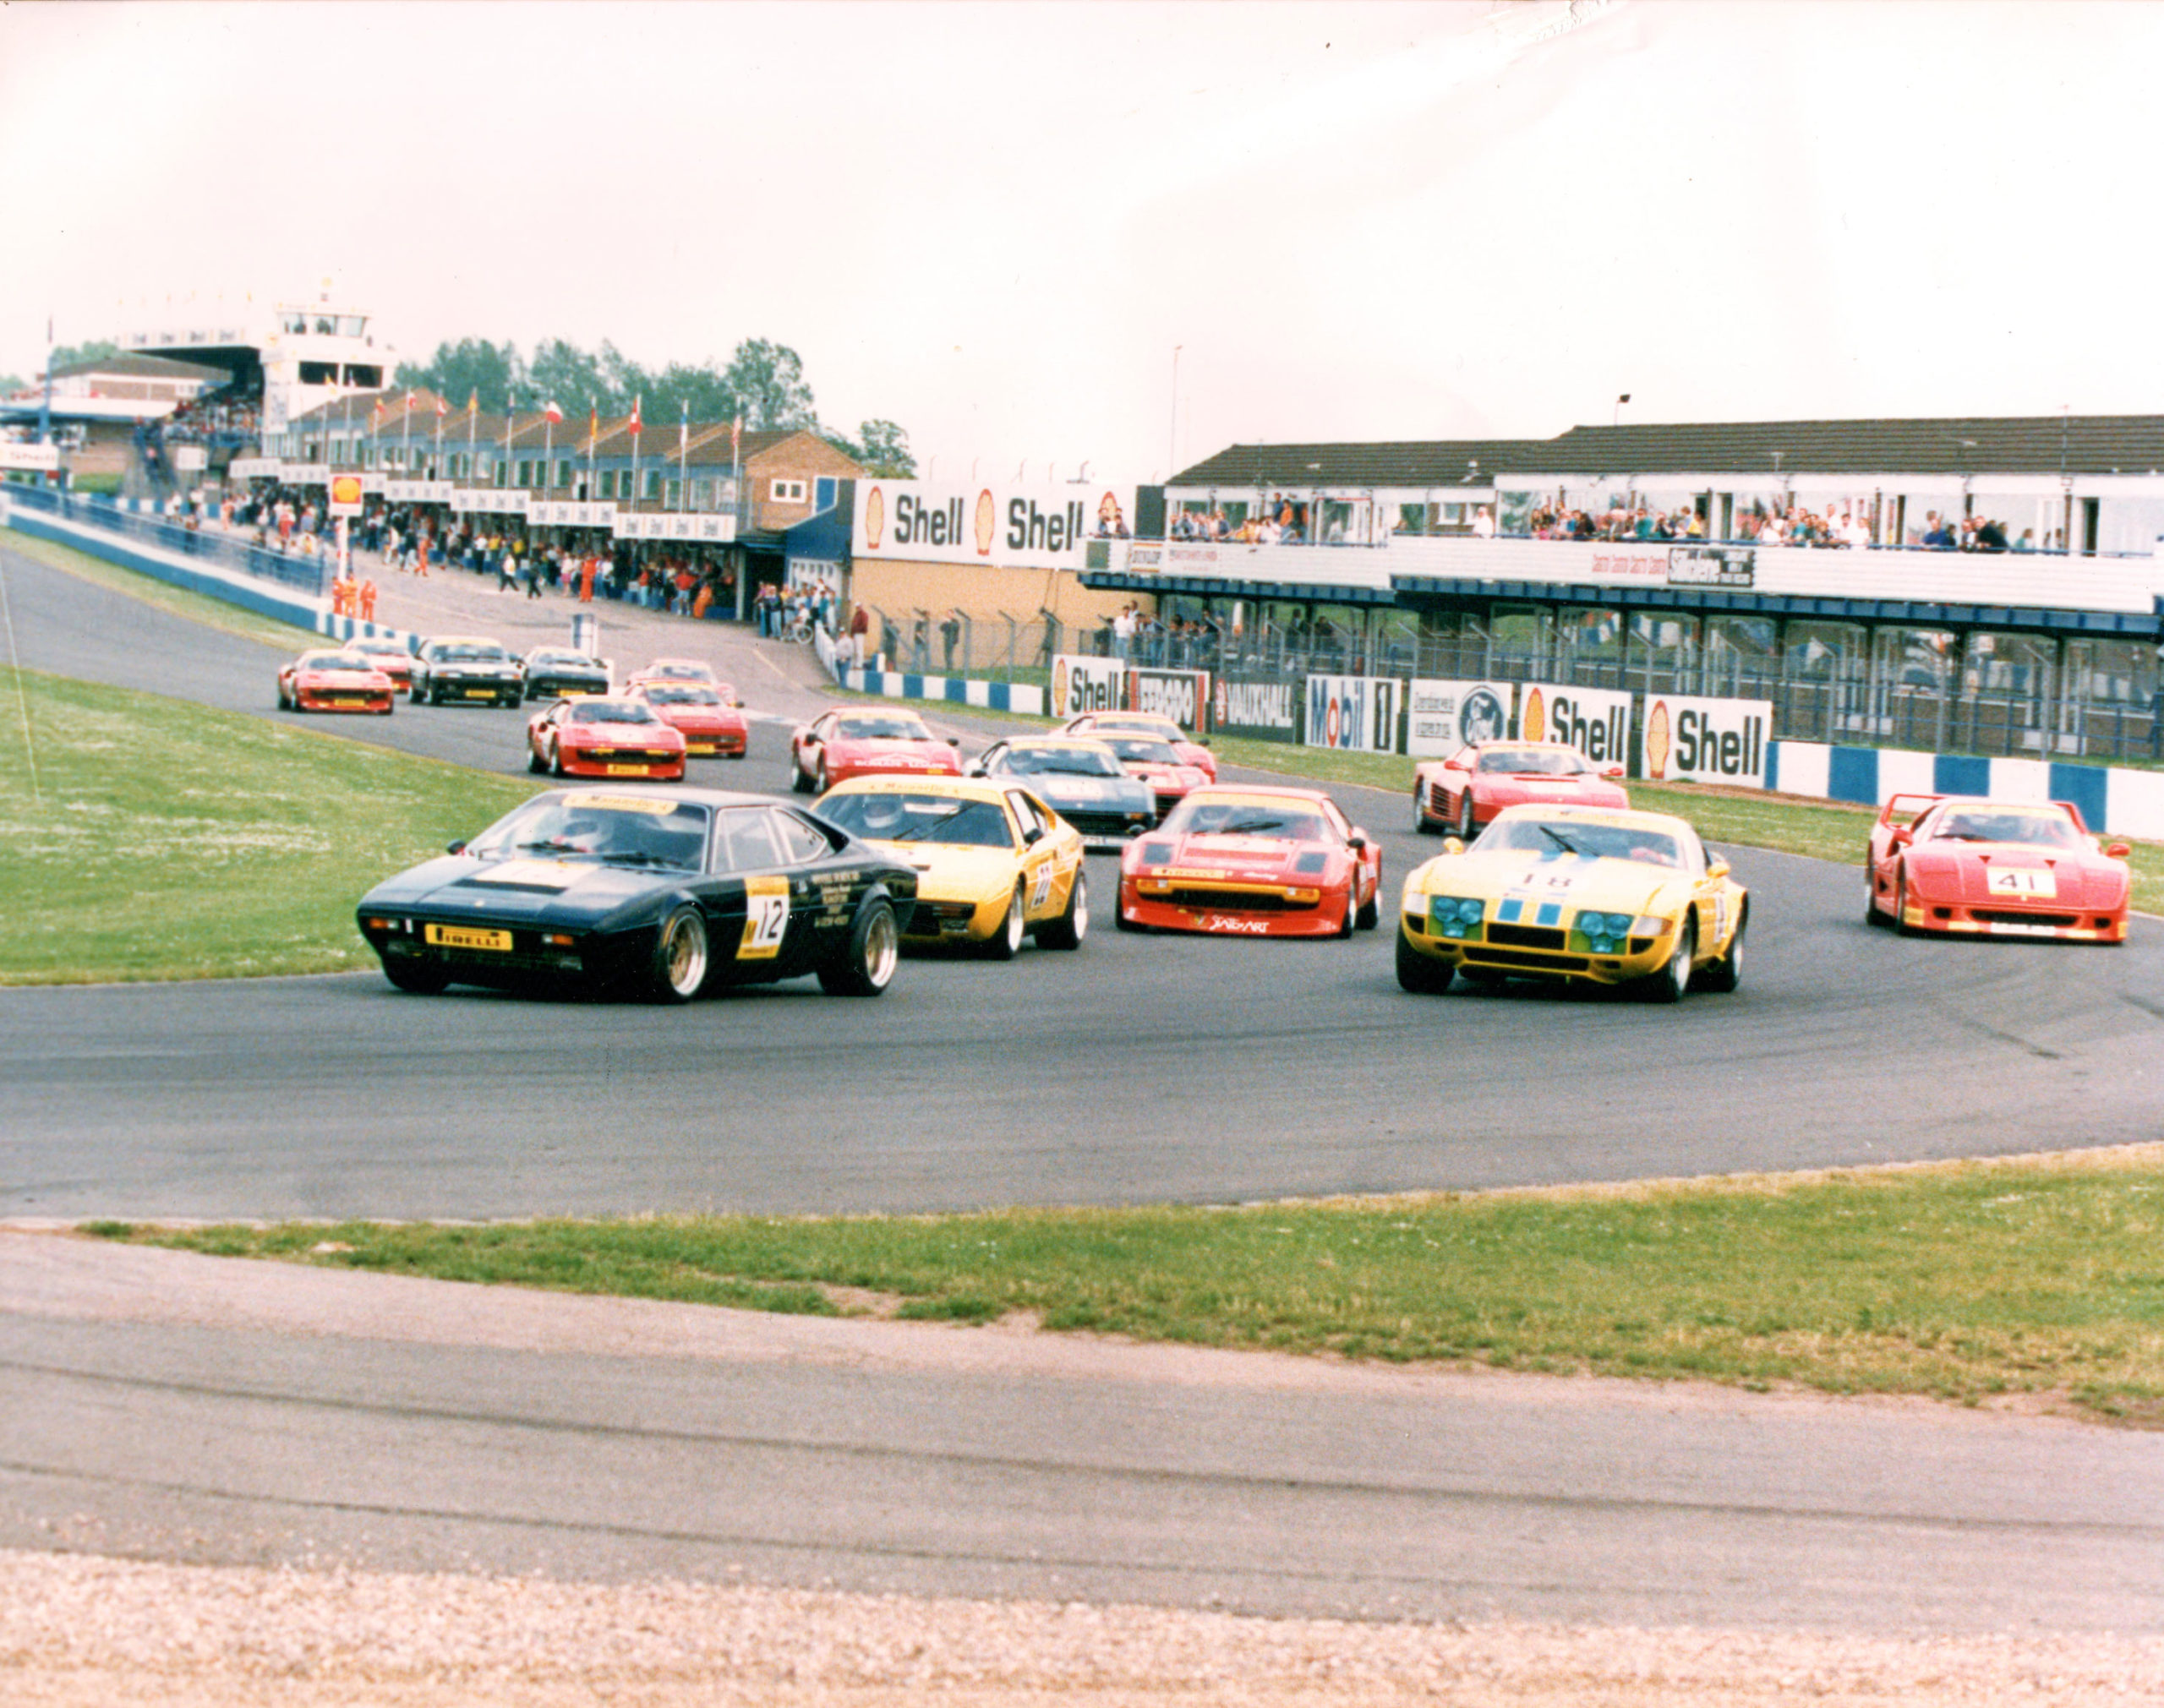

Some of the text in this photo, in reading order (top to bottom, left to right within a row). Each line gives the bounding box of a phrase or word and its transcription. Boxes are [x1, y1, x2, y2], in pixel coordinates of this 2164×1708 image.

[894, 494, 964, 545] Shell
[1007, 498, 1084, 552] Shell
[1070, 666, 1118, 712] Shell
[1139, 677, 1194, 725] FERODO
[1227, 683, 1293, 728] VAUXHALL
[1310, 678, 1364, 748] Mobil
[1549, 696, 1626, 762] Shell
[1675, 709, 1762, 776] Shell
[1523, 873, 1572, 887] 18
[1997, 873, 2036, 891] 41
[436, 926, 500, 947] PIRELLI
[759, 899, 784, 940] 12
